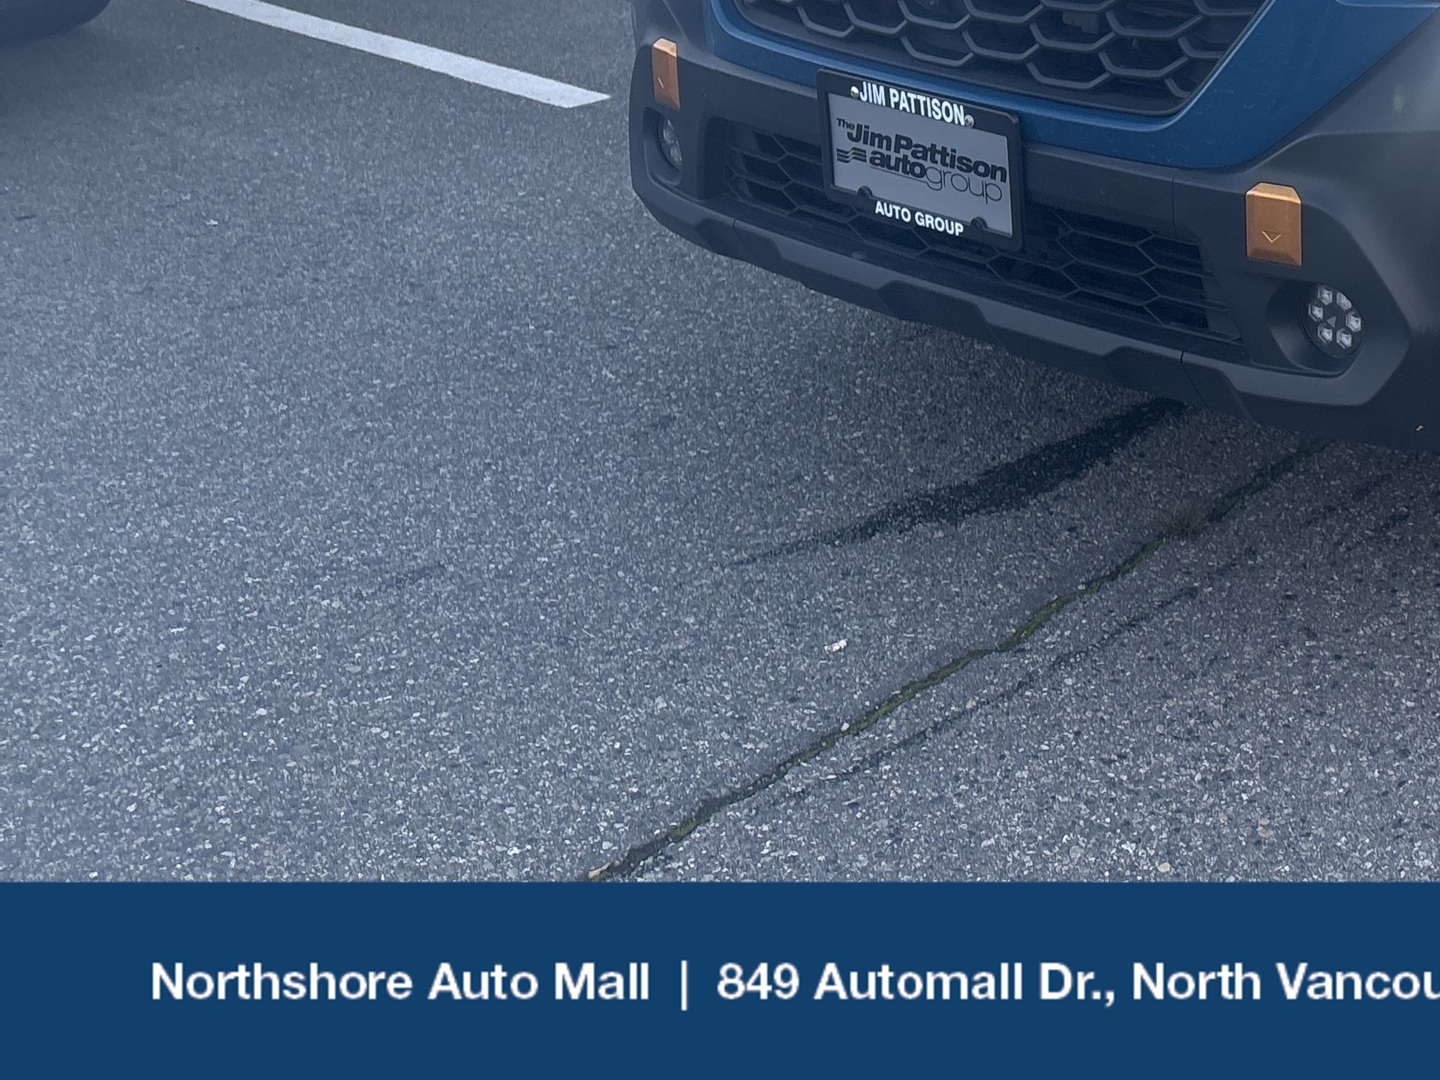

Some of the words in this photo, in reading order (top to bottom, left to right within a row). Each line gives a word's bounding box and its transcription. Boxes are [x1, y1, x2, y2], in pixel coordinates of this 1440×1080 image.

[836, 117, 856, 131] The
[859, 81, 886, 107] JIM
[889, 87, 965, 126] PATTISON
[846, 123, 892, 153] Jim
[894, 133, 1008, 183] Pattison
[875, 200, 911, 222] AUTO
[914, 211, 964, 237] GROUP
